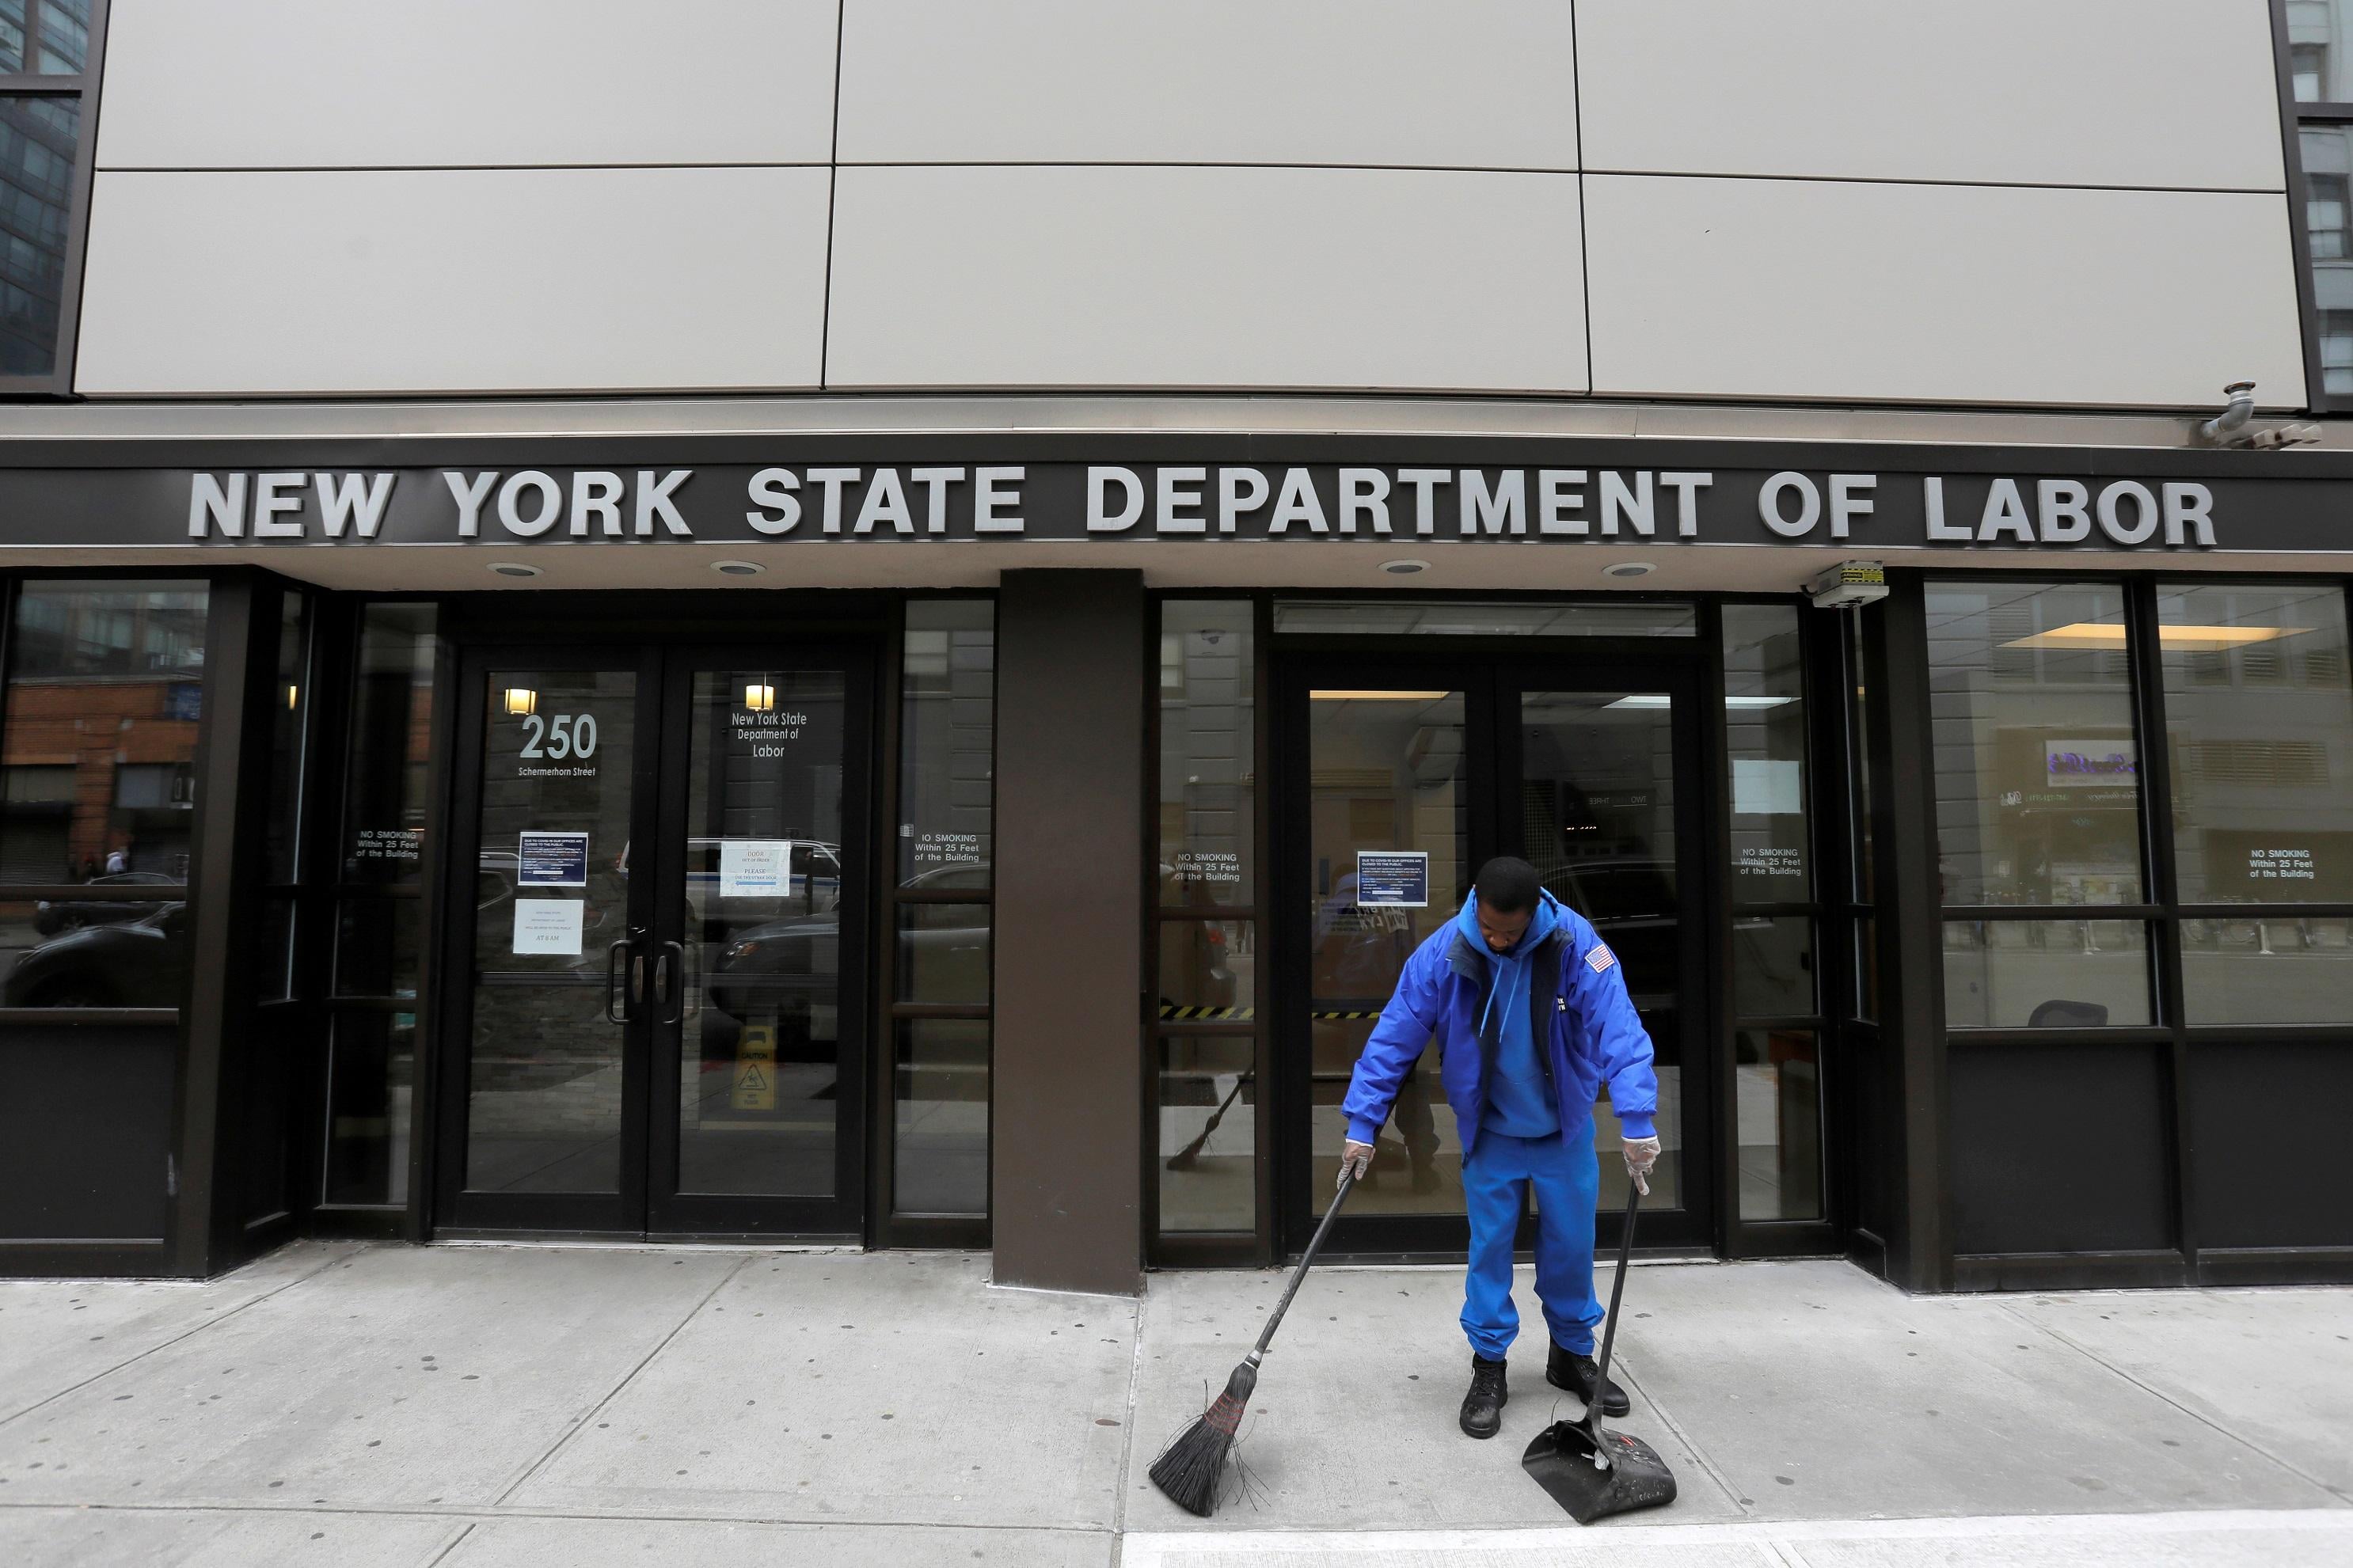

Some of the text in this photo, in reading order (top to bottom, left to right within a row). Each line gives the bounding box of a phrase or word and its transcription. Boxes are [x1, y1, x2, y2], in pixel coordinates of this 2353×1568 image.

[188, 466, 2217, 546] NEW YORK STATE DEPARTMENT OF LABOR
[732, 712, 807, 726] New York State
[519, 714, 597, 759] 250
[738, 728, 799, 742] Department of
[753, 744, 785, 757] Labor
[519, 767, 595, 776] Schermerhorn Street
[360, 830, 417, 839] NO SMOKING
[914, 843, 941, 852] Within
[386, 849, 419, 860] Building
[945, 853, 979, 863] Building
[1195, 853, 1237, 862] SMOKING
[2251, 849, 2310, 858] NO SMOKING
[1206, 872, 1240, 883] Building
[1770, 868, 1802, 877] Building
[2280, 870, 2314, 879] Building
